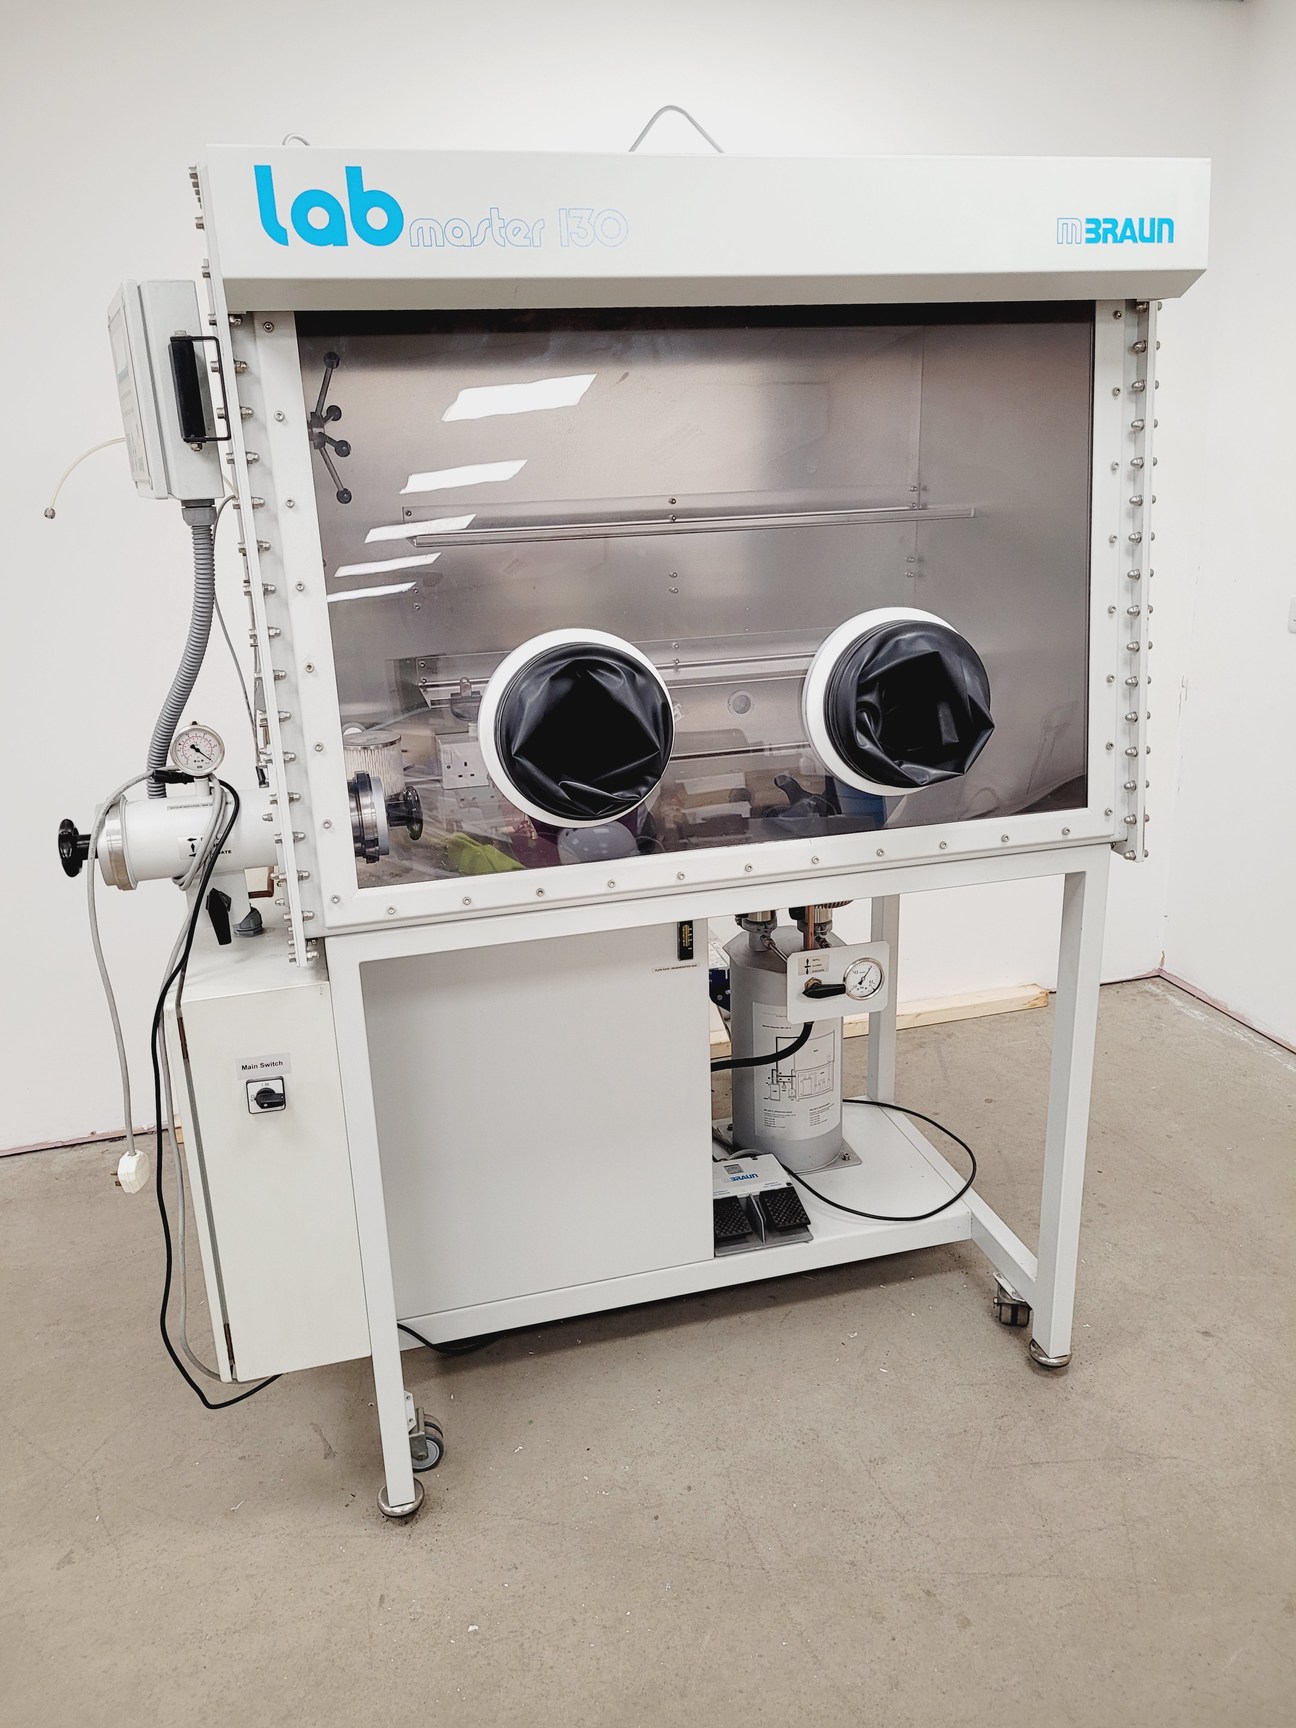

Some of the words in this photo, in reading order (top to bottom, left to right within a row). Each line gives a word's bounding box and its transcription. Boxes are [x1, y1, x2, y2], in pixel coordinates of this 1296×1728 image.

[253, 164, 405, 247] lab
[409, 206, 546, 248] master
[558, 206, 629, 248] 130
